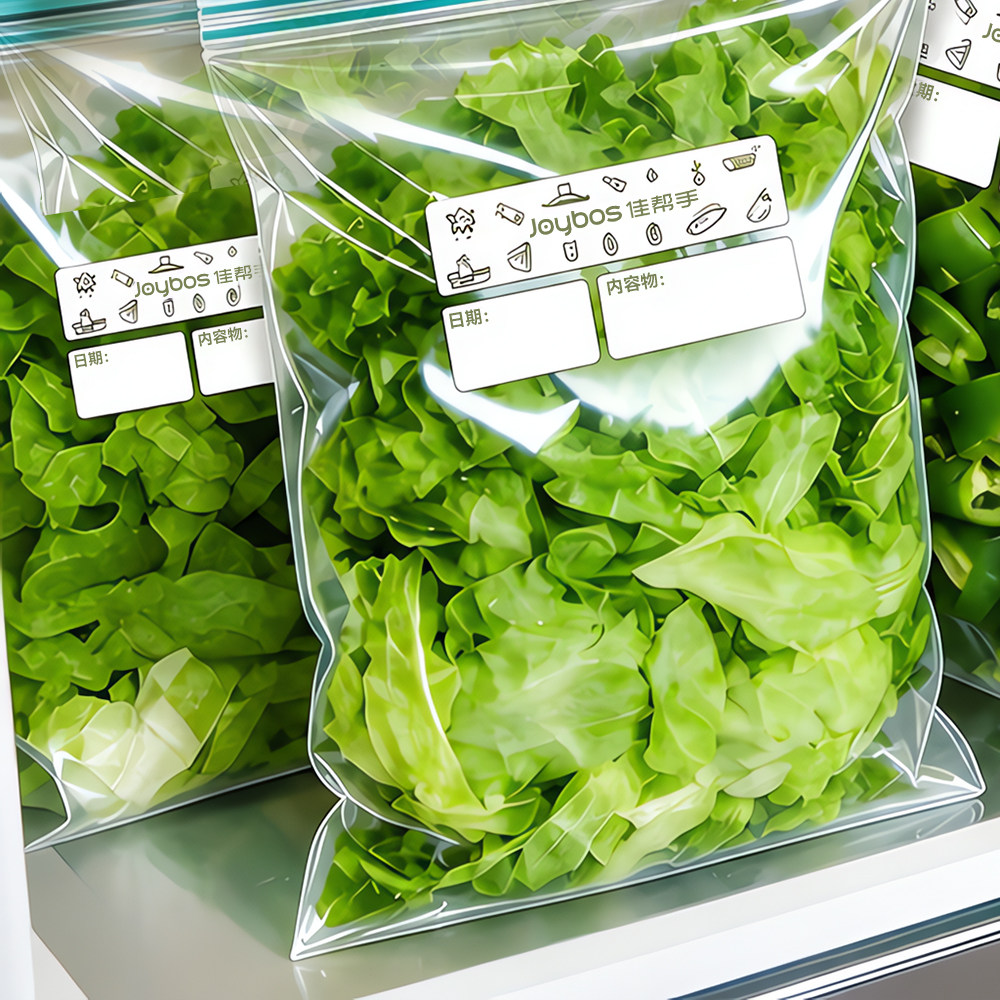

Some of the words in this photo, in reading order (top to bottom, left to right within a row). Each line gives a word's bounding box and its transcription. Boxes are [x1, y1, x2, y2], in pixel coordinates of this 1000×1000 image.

[914, 82, 940, 102] 期：
[529, 205, 622, 238] Joybos
[625, 189, 698, 219] 佳帮手
[134, 273, 210, 298] Joybos
